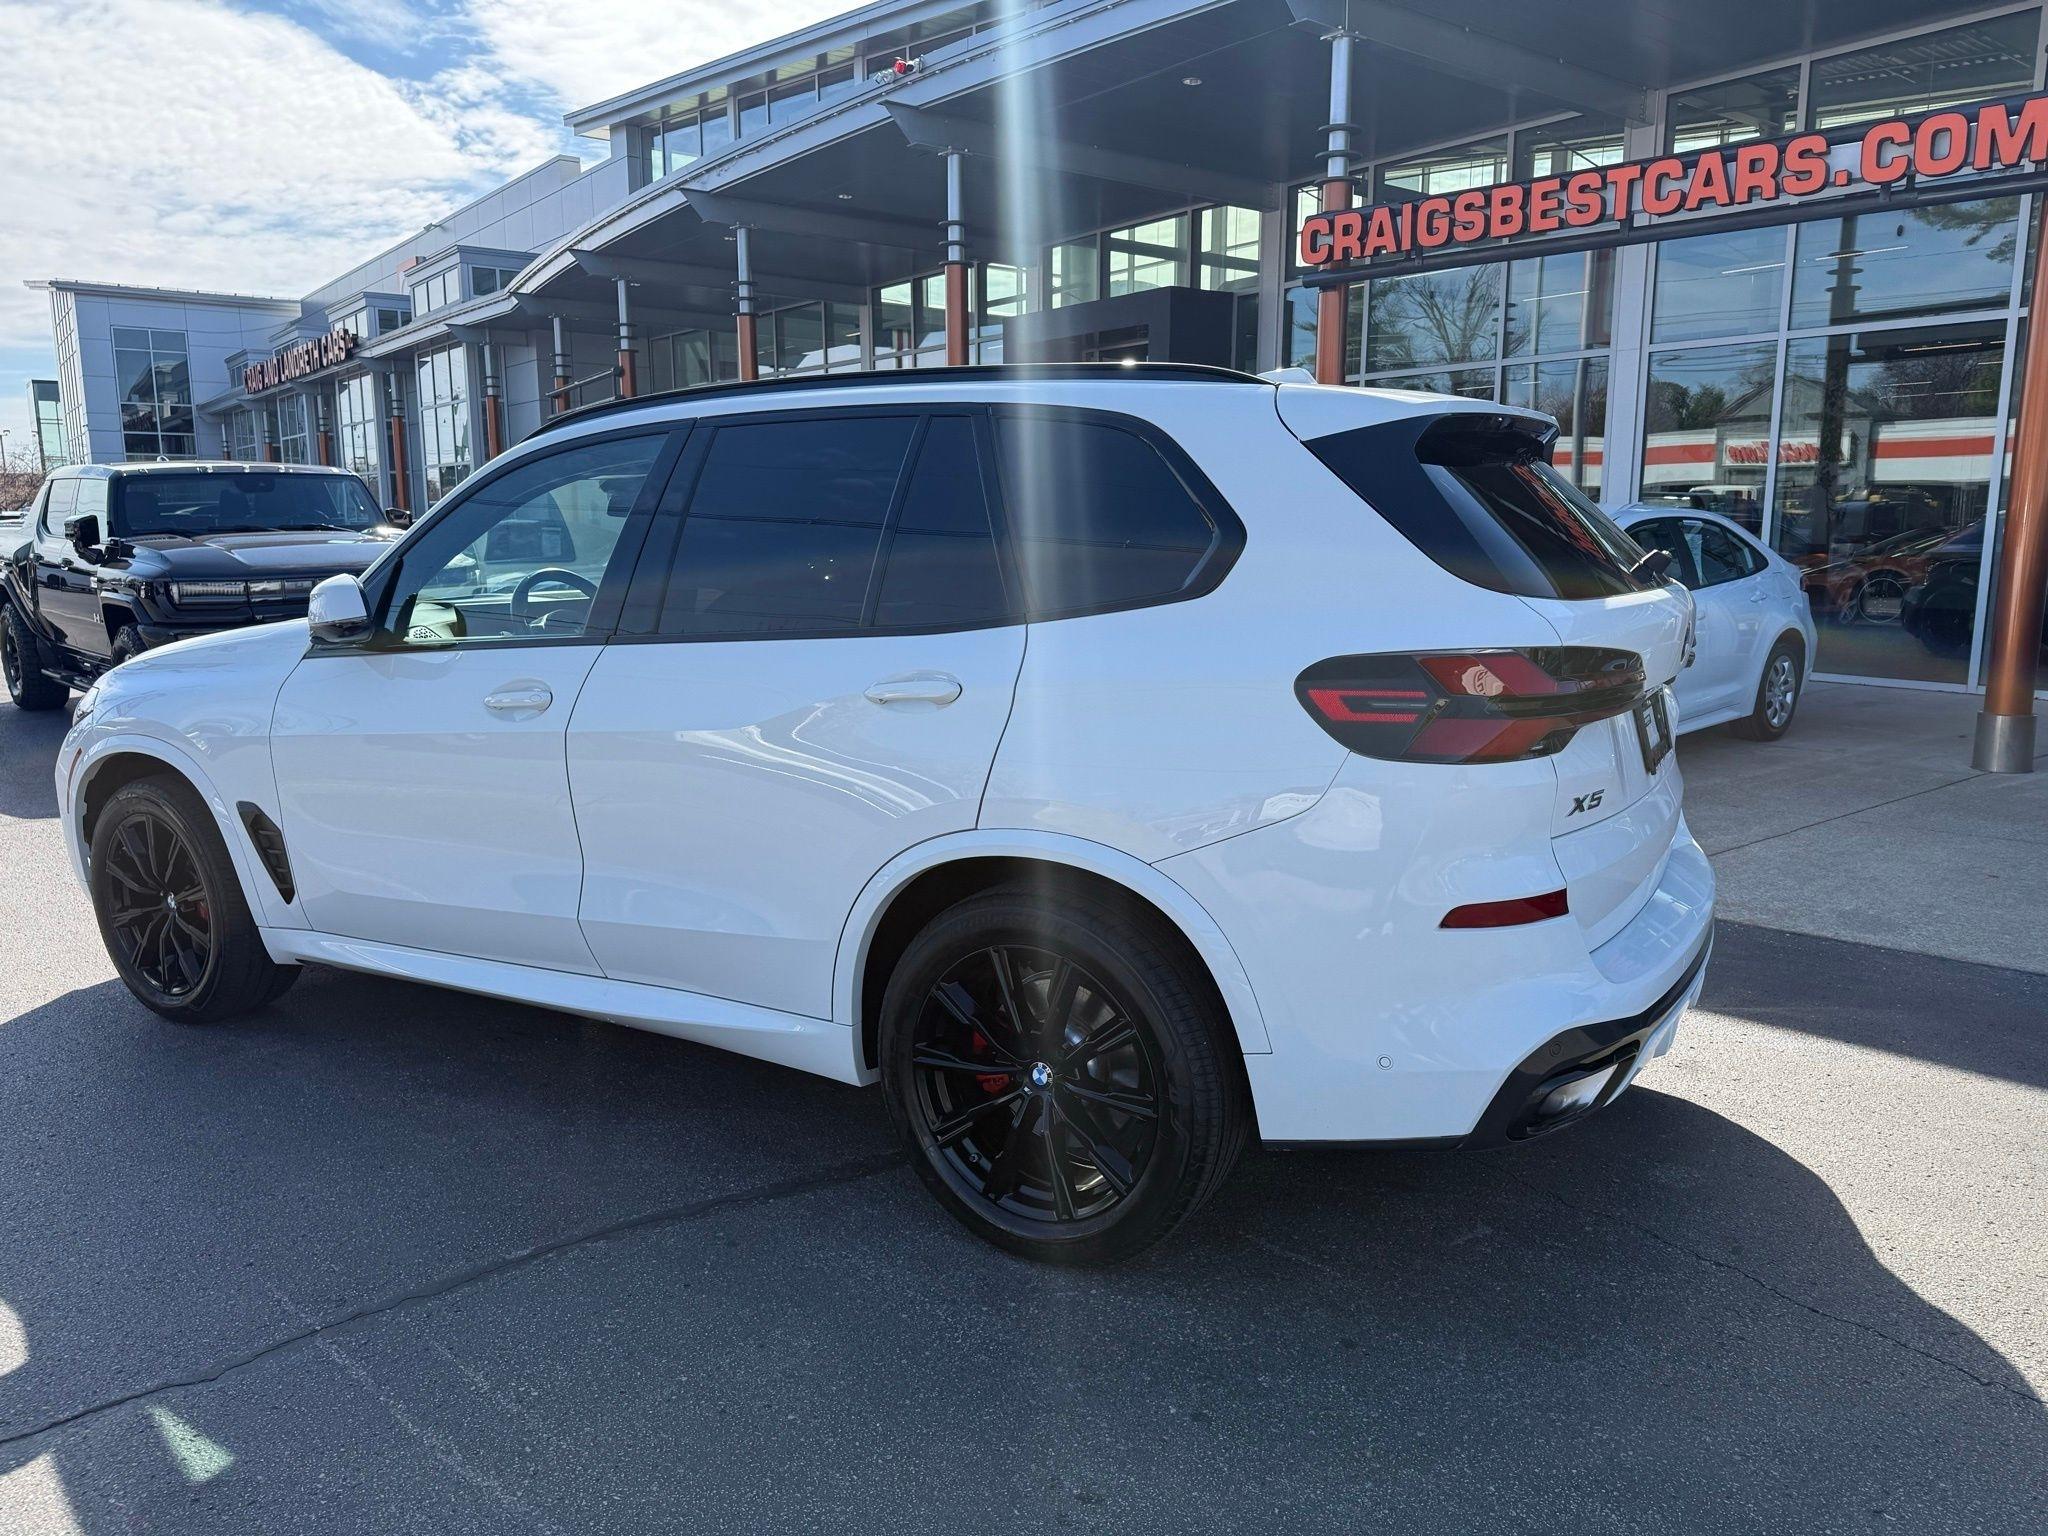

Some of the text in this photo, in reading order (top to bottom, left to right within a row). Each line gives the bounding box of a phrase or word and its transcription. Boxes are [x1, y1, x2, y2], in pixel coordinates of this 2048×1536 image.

[1300, 96, 2048, 266] CRAIGSBESTCARS.COM
[263, 357, 279, 388] AND
[280, 339, 320, 382] LANDRETH
[321, 328, 346, 368] CARS
[1566, 789, 1605, 817] X5
